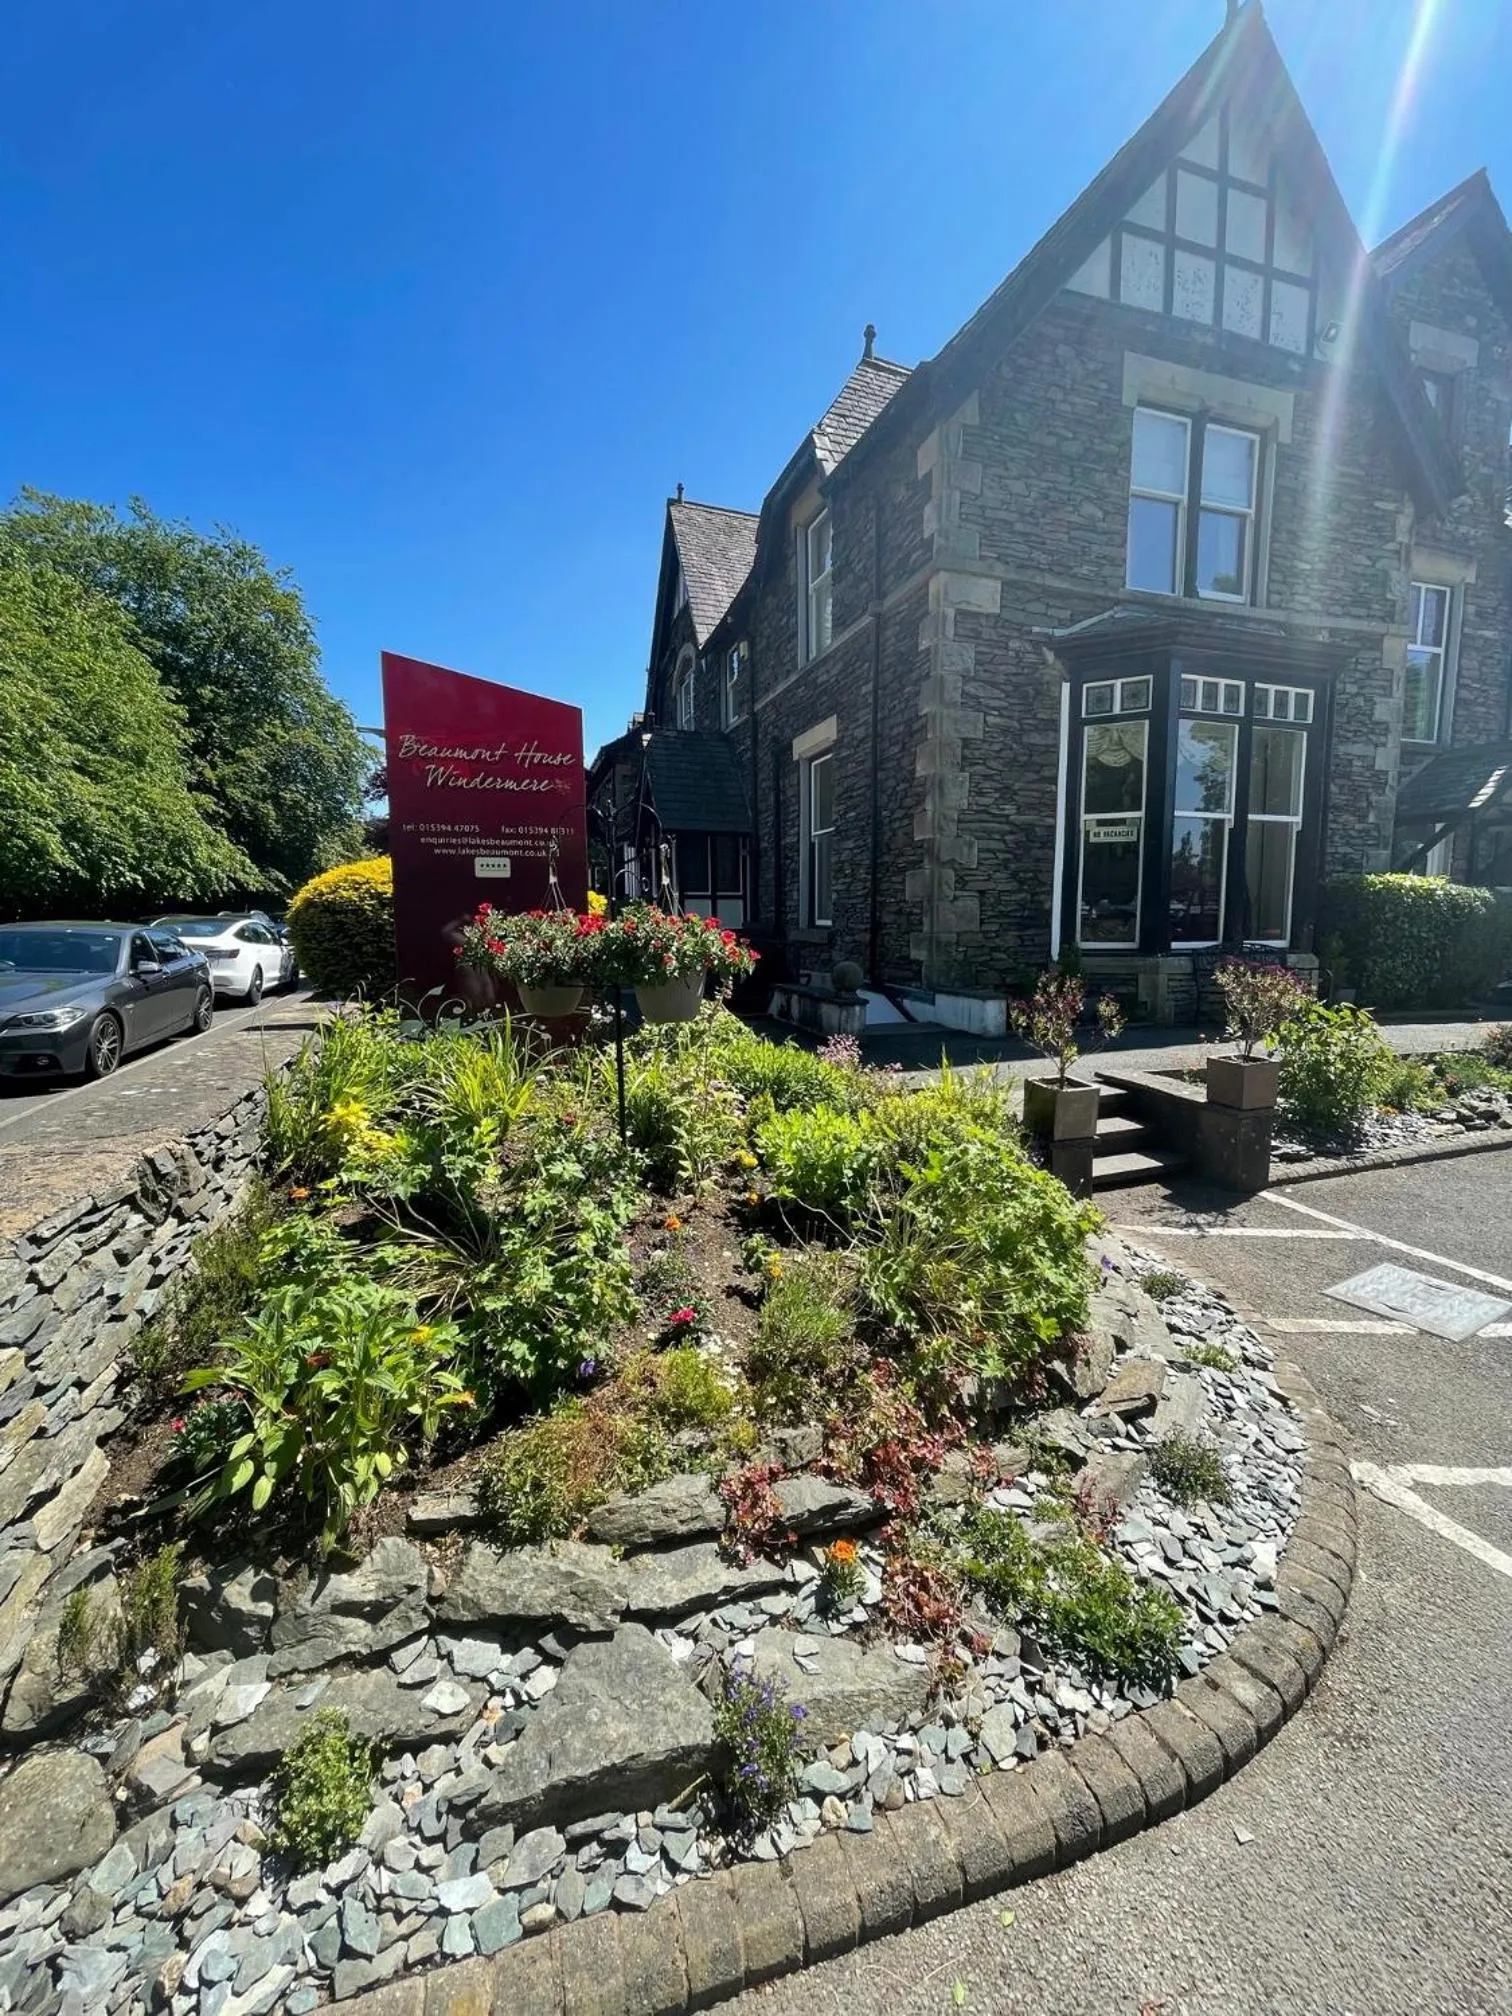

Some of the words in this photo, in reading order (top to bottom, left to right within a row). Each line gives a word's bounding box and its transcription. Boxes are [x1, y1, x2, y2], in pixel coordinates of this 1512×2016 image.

[398, 734, 508, 763] Beaumont
[514, 741, 576, 768] House
[425, 764, 554, 792] Windermere
